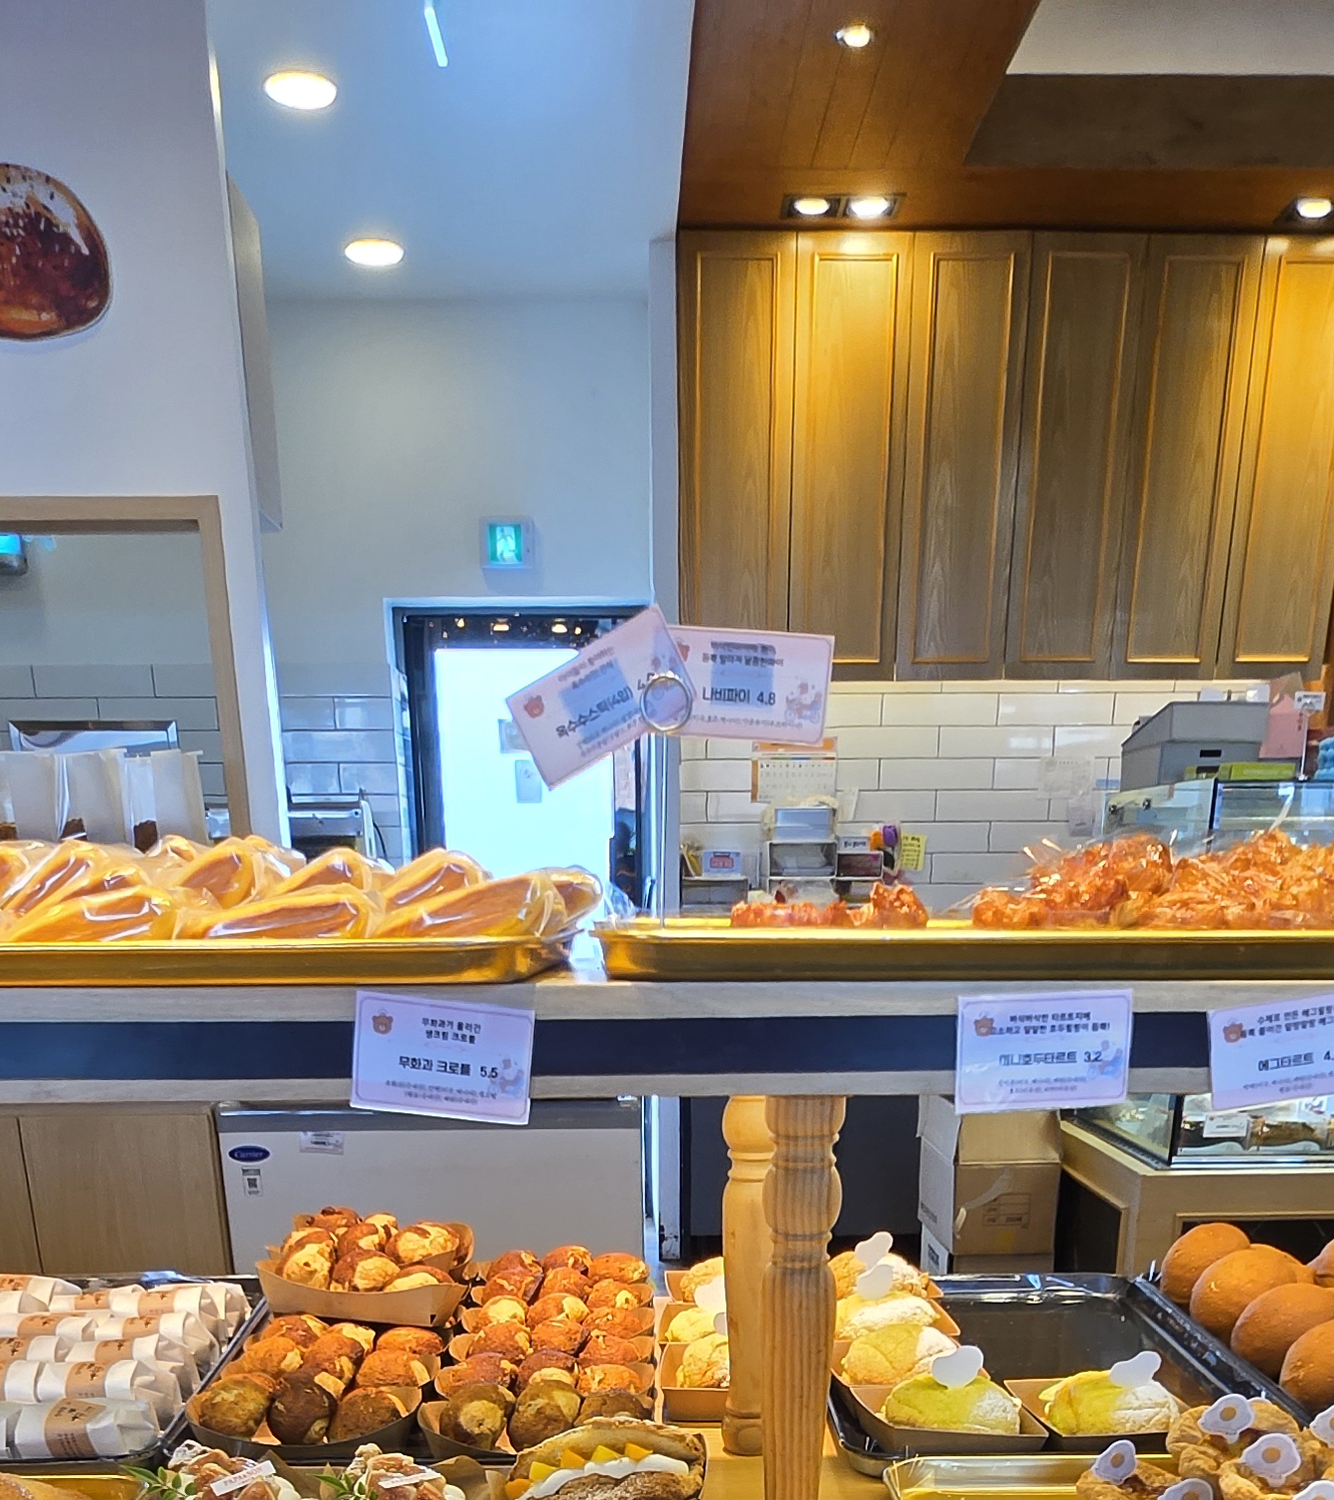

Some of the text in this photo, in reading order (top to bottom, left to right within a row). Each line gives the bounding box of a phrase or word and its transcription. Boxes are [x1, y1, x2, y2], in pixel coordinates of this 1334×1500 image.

[703, 687, 776, 706] 나비파이 4.8
[399, 1055, 499, 1079] 무화과 크로플 5.5
[998, 1051, 1103, 1067] 미니호두타르트 3.2
[1258, 1052, 1315, 1071] 에그타르트
